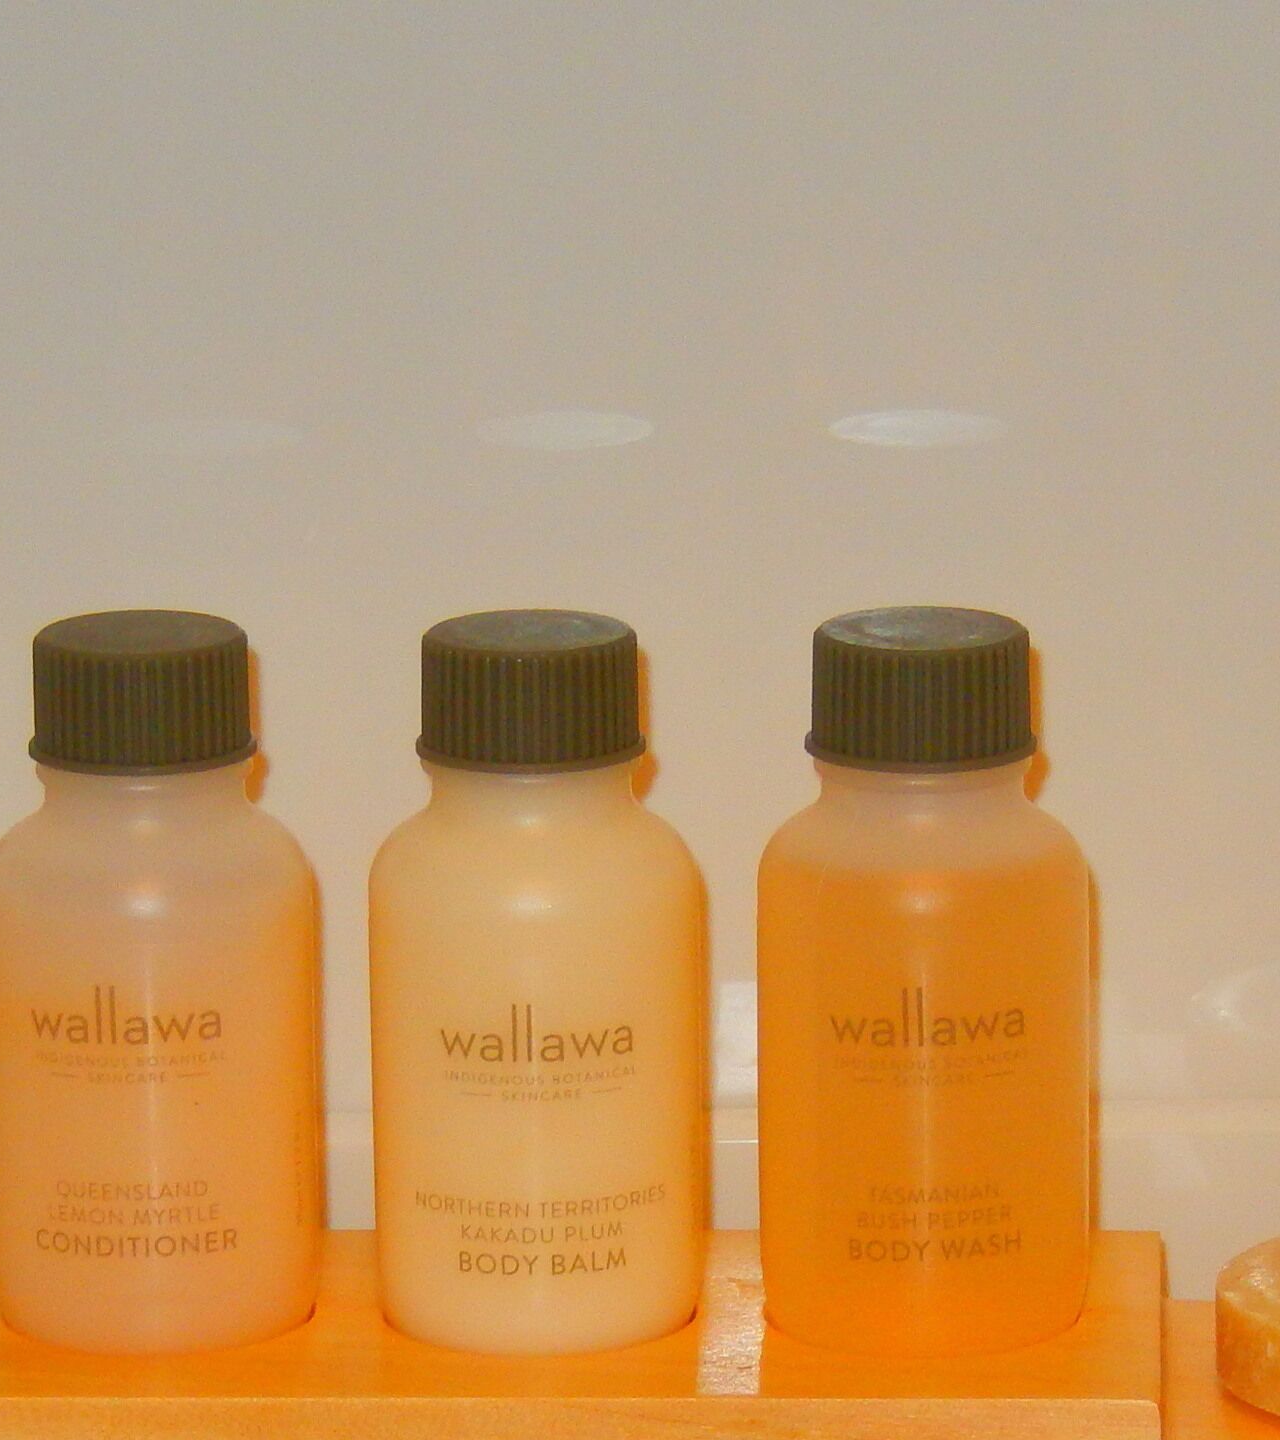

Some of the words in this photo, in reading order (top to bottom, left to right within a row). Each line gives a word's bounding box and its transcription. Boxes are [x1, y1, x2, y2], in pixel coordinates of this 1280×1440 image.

[31, 985, 223, 1046] wallawa
[829, 987, 1027, 1047] wallawa
[440, 1003, 634, 1063] wallawa
[444, 1069, 545, 1087] INDIGENOUS
[552, 1064, 638, 1085] BOTANICAL
[501, 1088, 583, 1103] SKINCARE
[56, 1179, 209, 1201] QUEENSLAND
[415, 1190, 531, 1219] NORTHERN
[539, 1182, 666, 1219] TERRITORIES
[869, 1182, 1001, 1206] TASMANIAN
[48, 1203, 125, 1226] LEMON
[132, 1202, 221, 1227] MYRTLE
[856, 1210, 918, 1230] BUSH
[926, 1203, 1014, 1231] PEPPER
[35, 1228, 239, 1259] CONDITIONER
[460, 1223, 556, 1244] KAKADU
[563, 1220, 624, 1243] PLUM
[847, 1237, 931, 1263] BODY
[939, 1229, 1023, 1262] WASH
[458, 1250, 540, 1277] BODY
[550, 1246, 628, 1277] BALM
